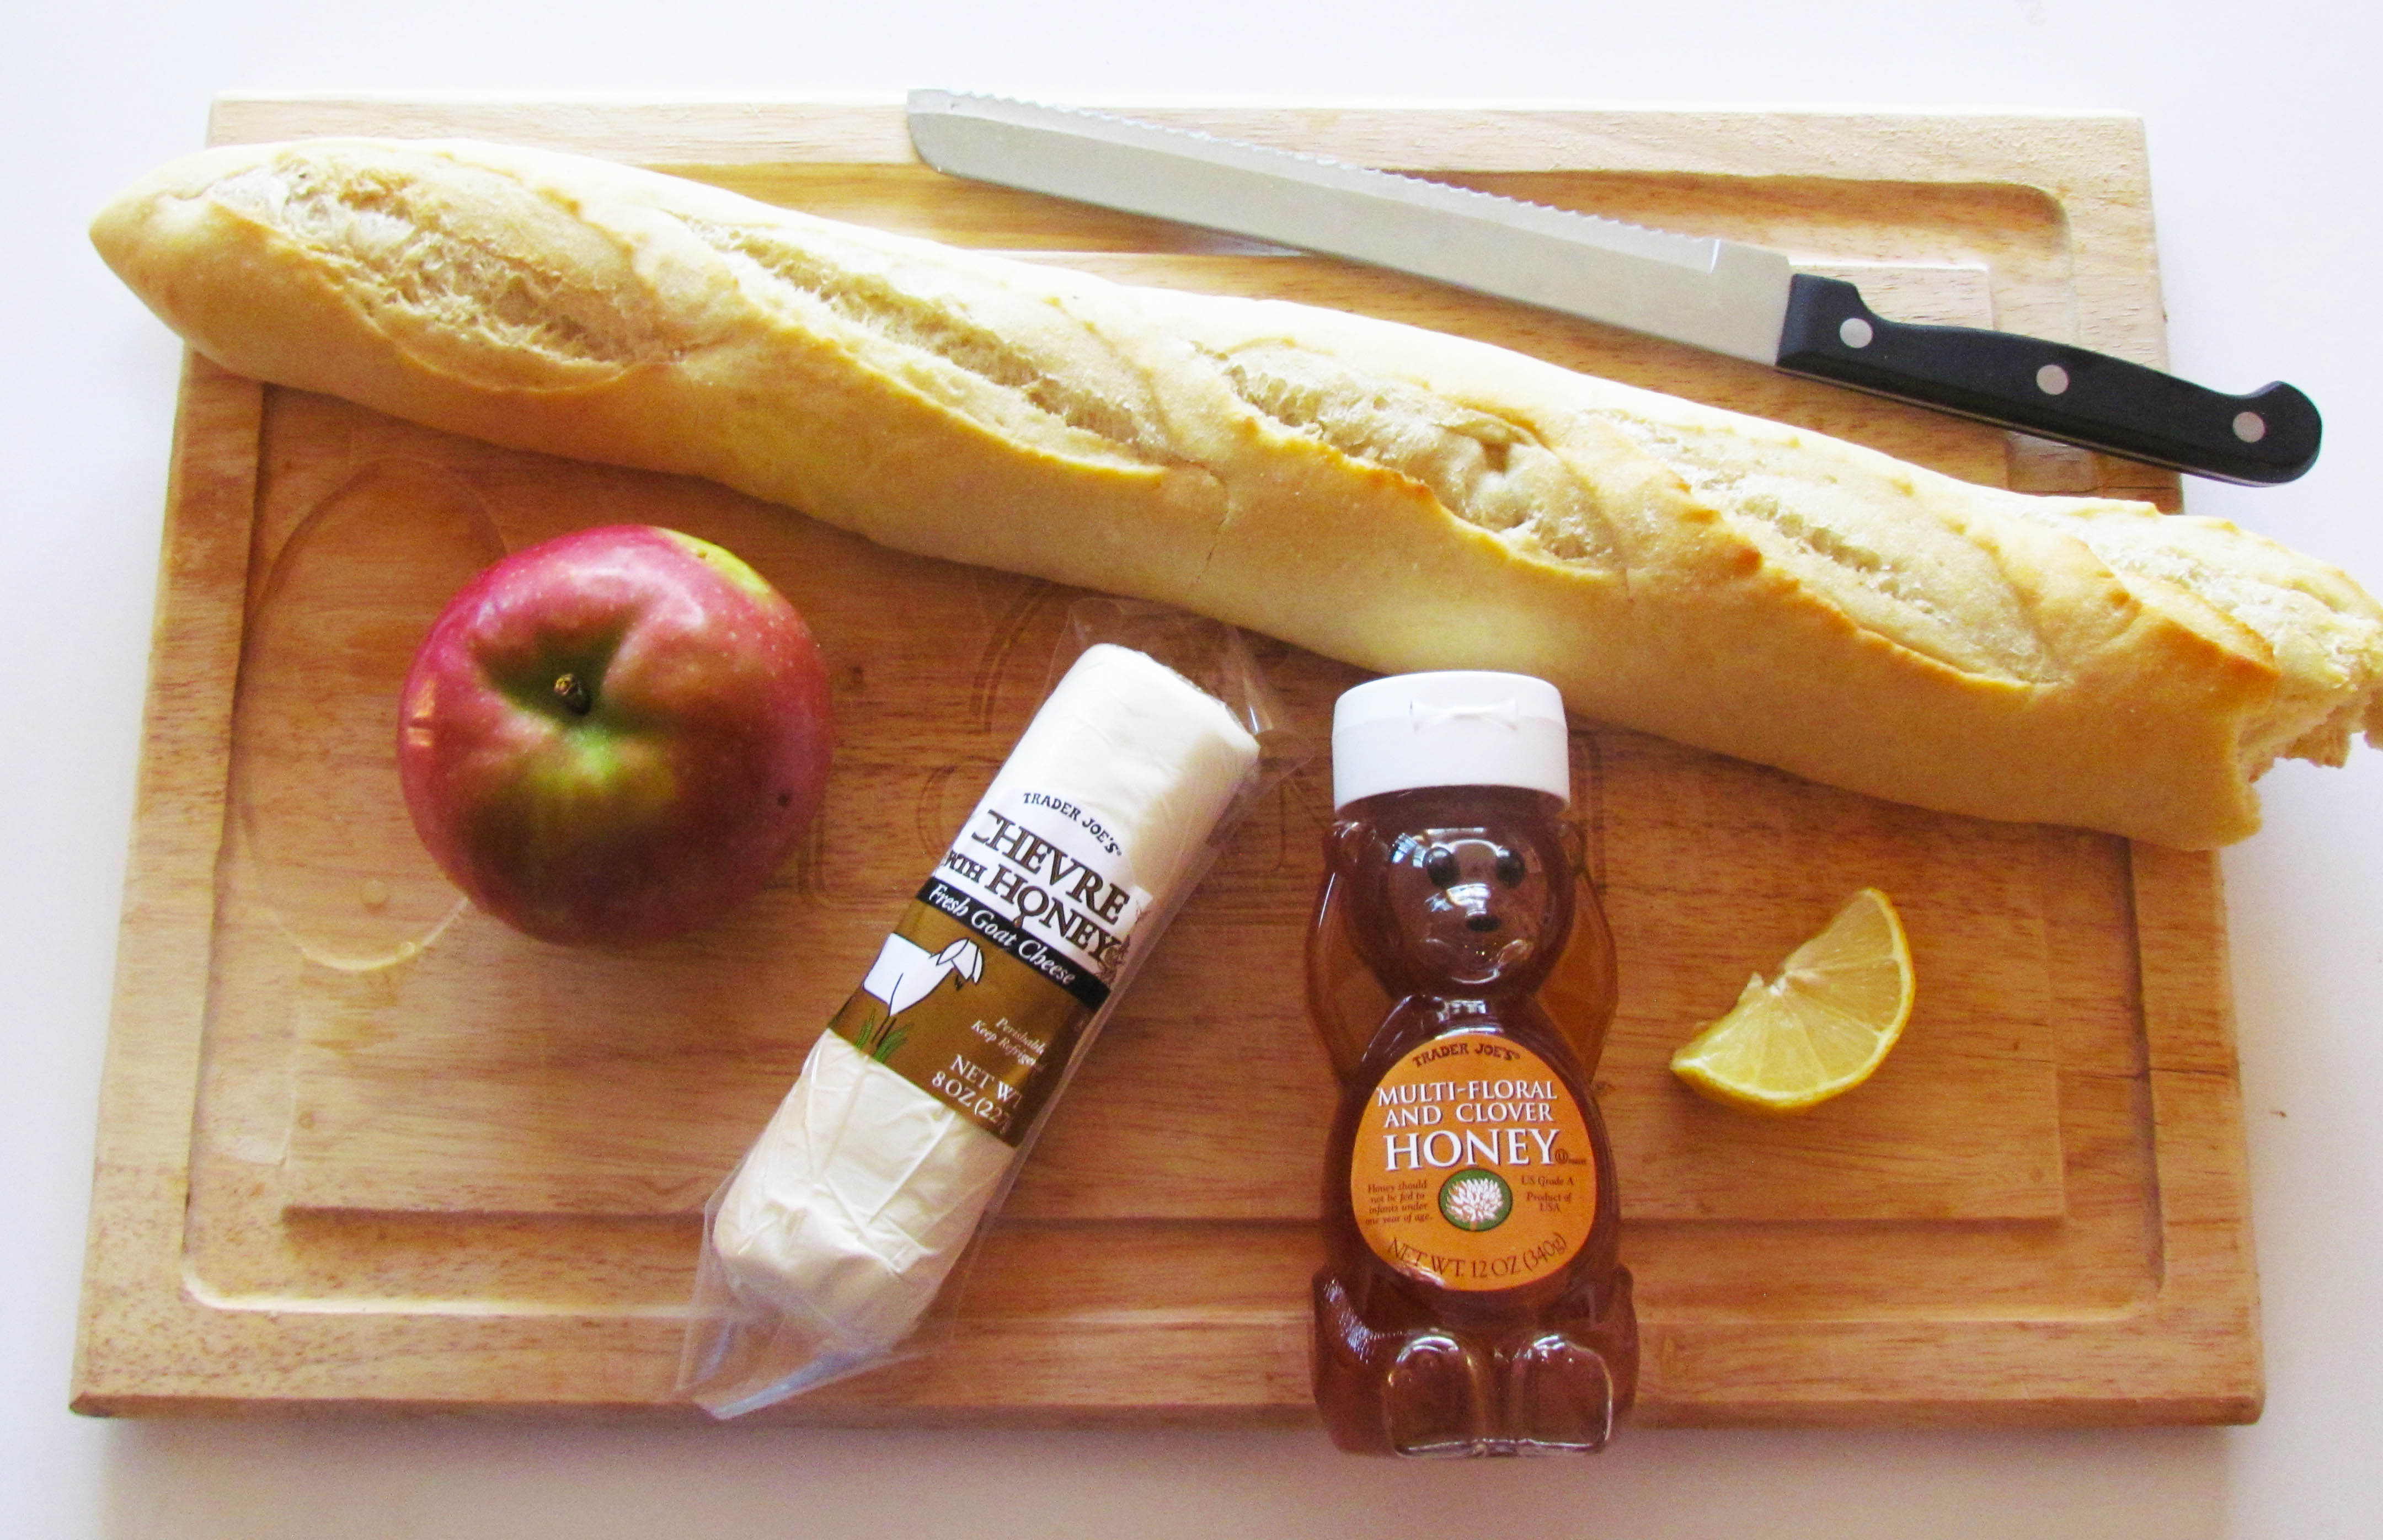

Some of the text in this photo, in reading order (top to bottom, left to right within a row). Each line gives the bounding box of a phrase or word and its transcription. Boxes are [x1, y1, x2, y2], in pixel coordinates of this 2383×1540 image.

[1023, 793, 1081, 821] TRADER
[984, 863, 1121, 962] HONEY
[928, 883, 1076, 985] Fresh Goat Cheese
[971, 1019, 997, 1043] Keep
[1413, 1042, 1469, 1067] TRADER
[932, 1071, 946, 1087] 8
[949, 1054, 995, 1089] NET
[1376, 1079, 1558, 1107] MULTI-FLORAL
[1383, 1102, 1555, 1129] AND CLOVER
[1383, 1129, 1560, 1172] HONEY
[1398, 1180, 1427, 1190] should
[1538, 1176, 1564, 1186] Grade
[1402, 1202, 1428, 1211] under
[1526, 1191, 1561, 1201] Product
[1387, 1237, 1427, 1267] NET
[1471, 1260, 1488, 1278] 12
[1491, 1255, 1521, 1276] OZ
[1523, 1232, 1567, 1272] (340g)
